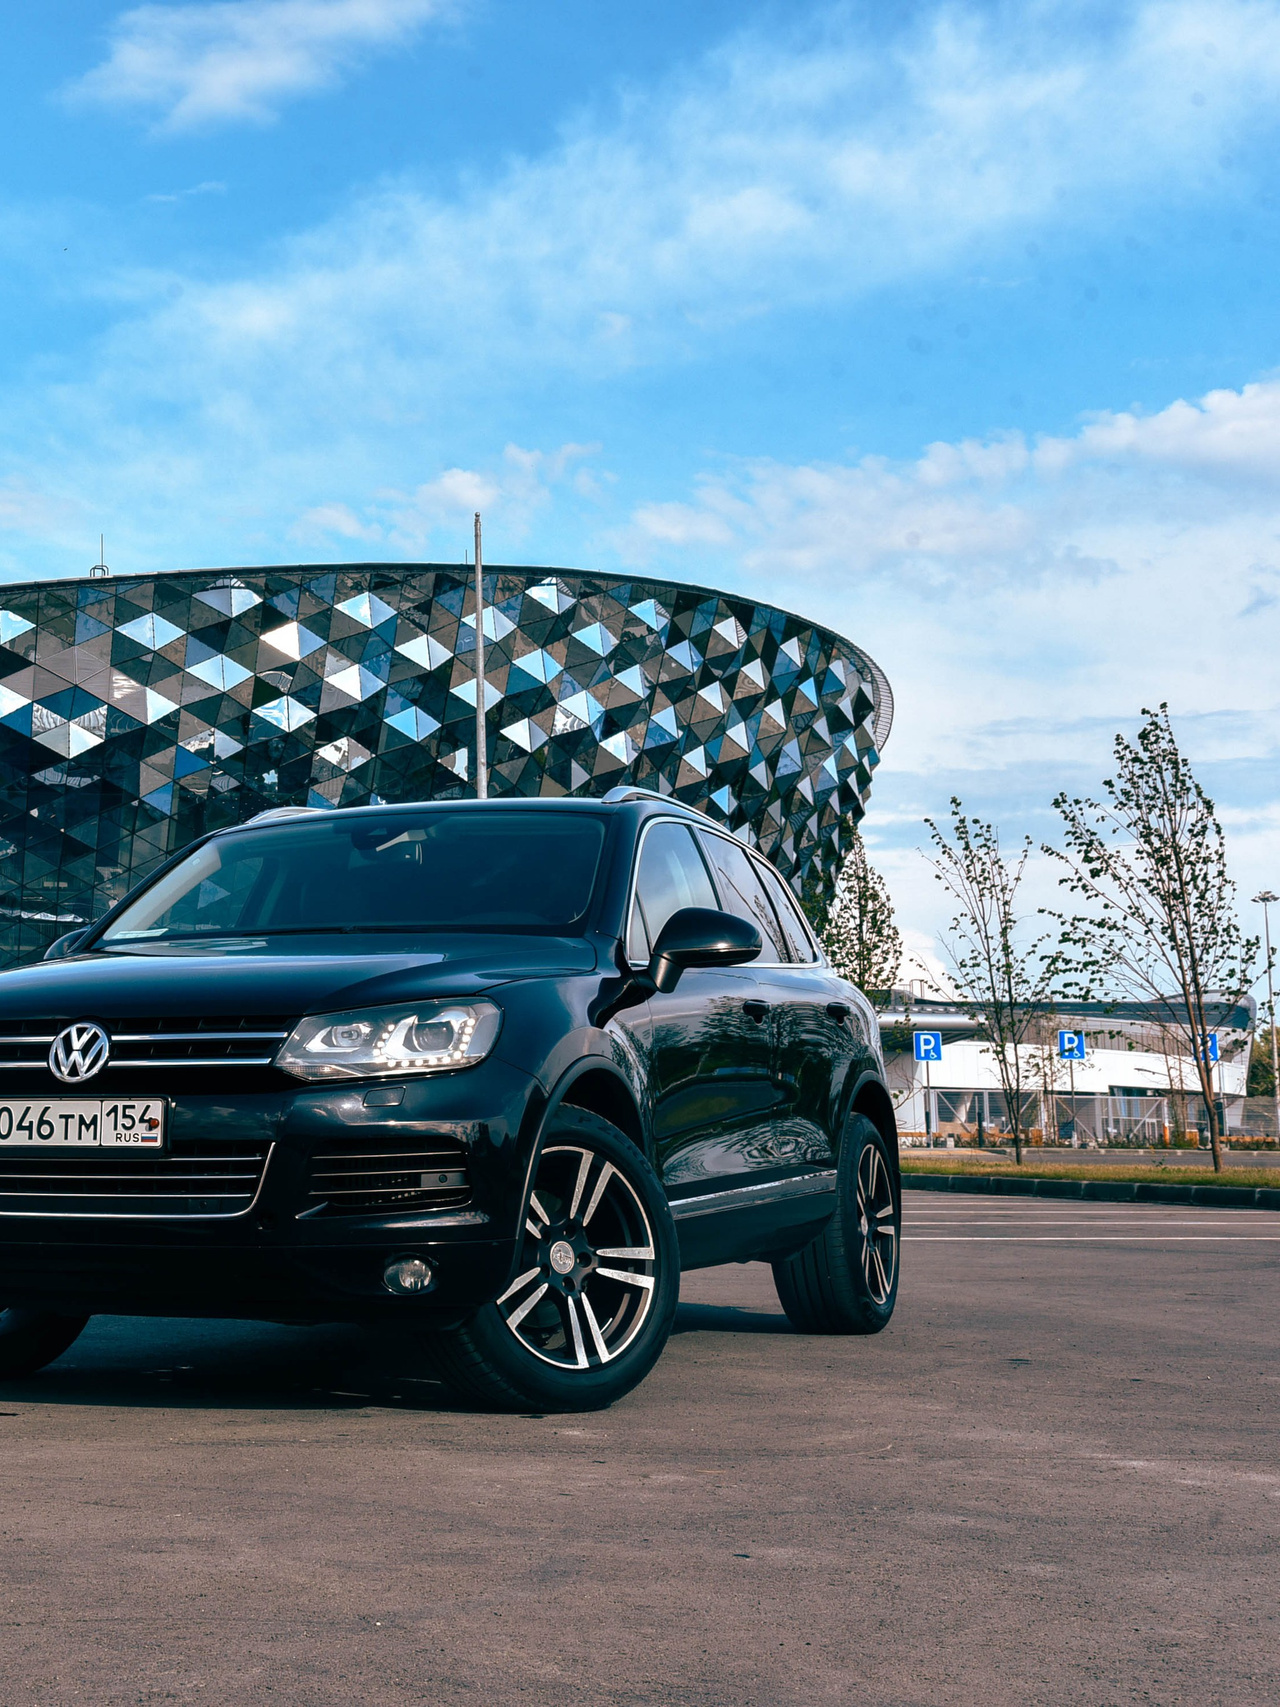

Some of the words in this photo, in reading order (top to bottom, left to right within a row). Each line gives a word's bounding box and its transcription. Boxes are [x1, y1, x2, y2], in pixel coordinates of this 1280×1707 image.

[920, 1035, 935, 1057] P
[1064, 1033, 1079, 1056] P
[105, 1104, 154, 1132] 154
[115, 1132, 140, 1143] RUS
